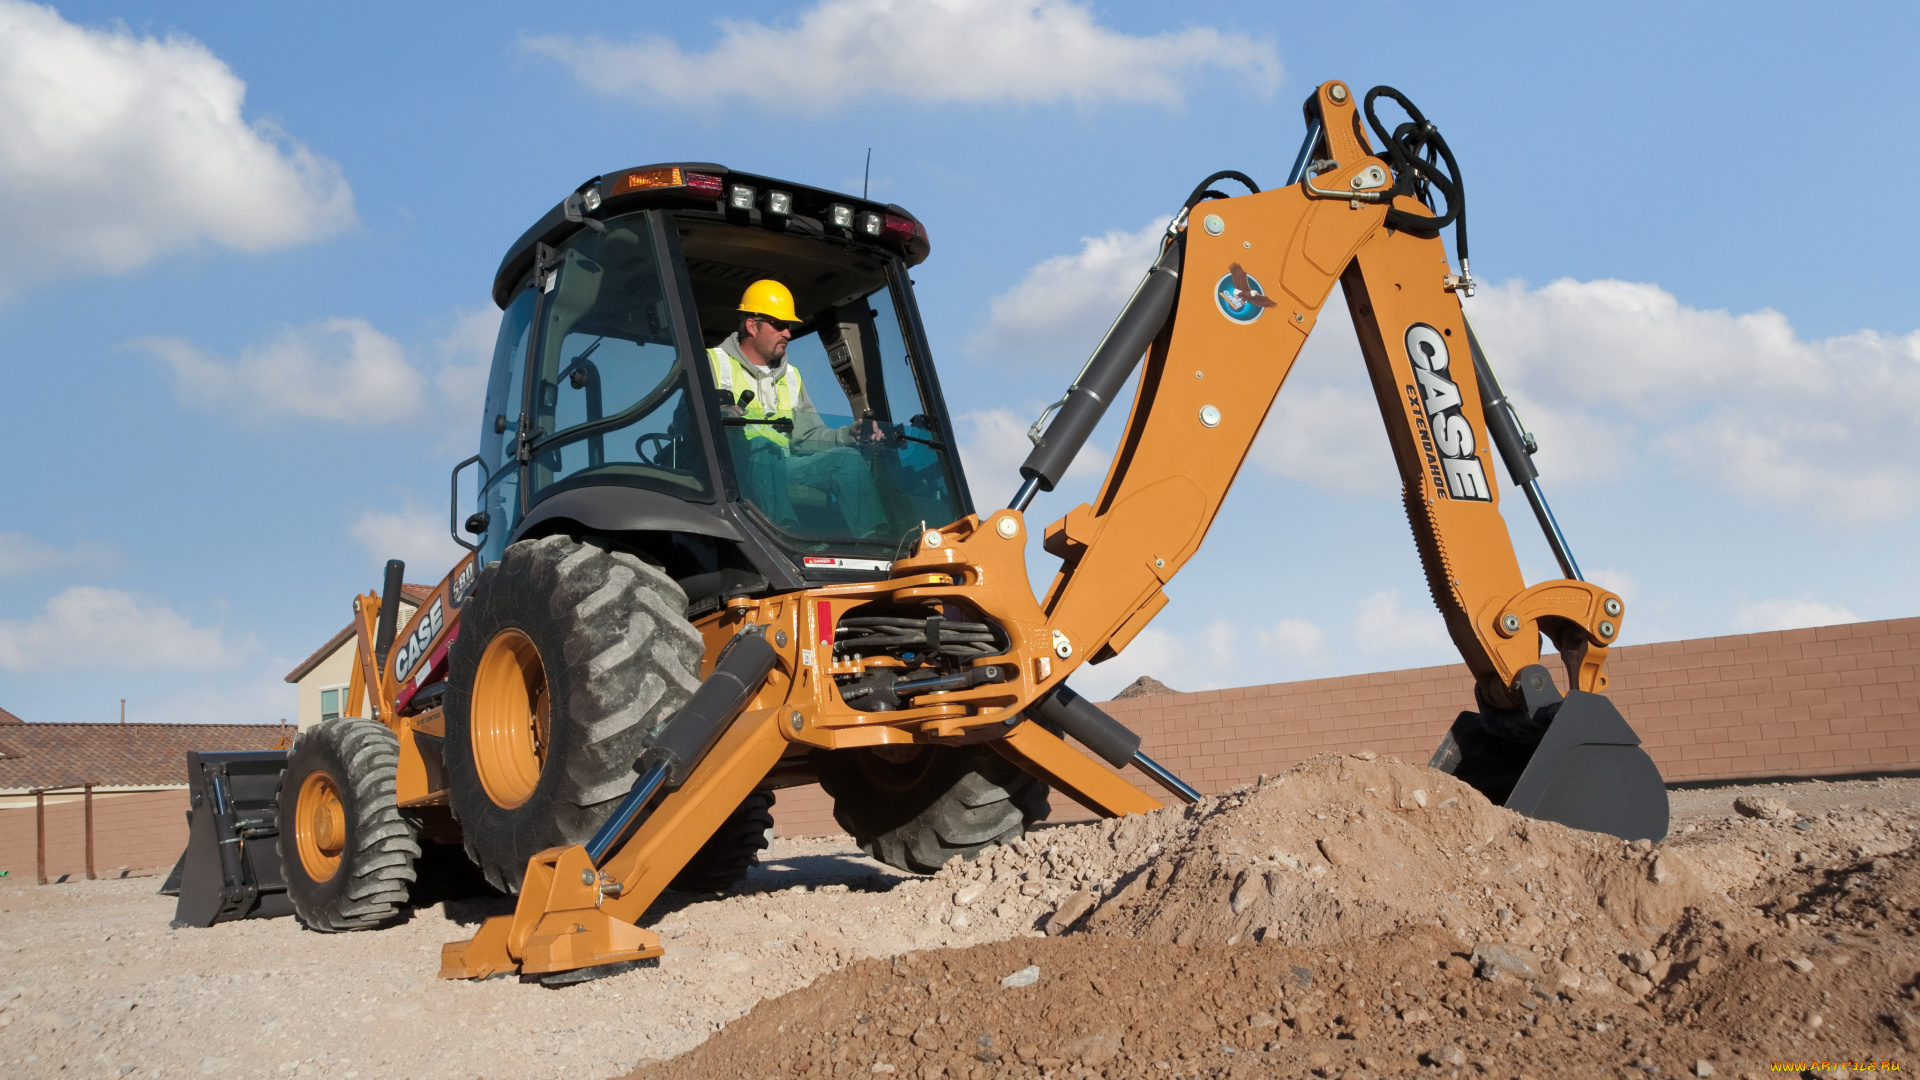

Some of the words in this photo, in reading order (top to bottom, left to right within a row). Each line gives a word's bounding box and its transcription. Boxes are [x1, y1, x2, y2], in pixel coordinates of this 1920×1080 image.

[1404, 322, 1493, 503] CASE
[1405, 384, 1449, 500] EXTENDAHOE
[453, 561, 474, 597] 580
[395, 594, 444, 683] CASE
